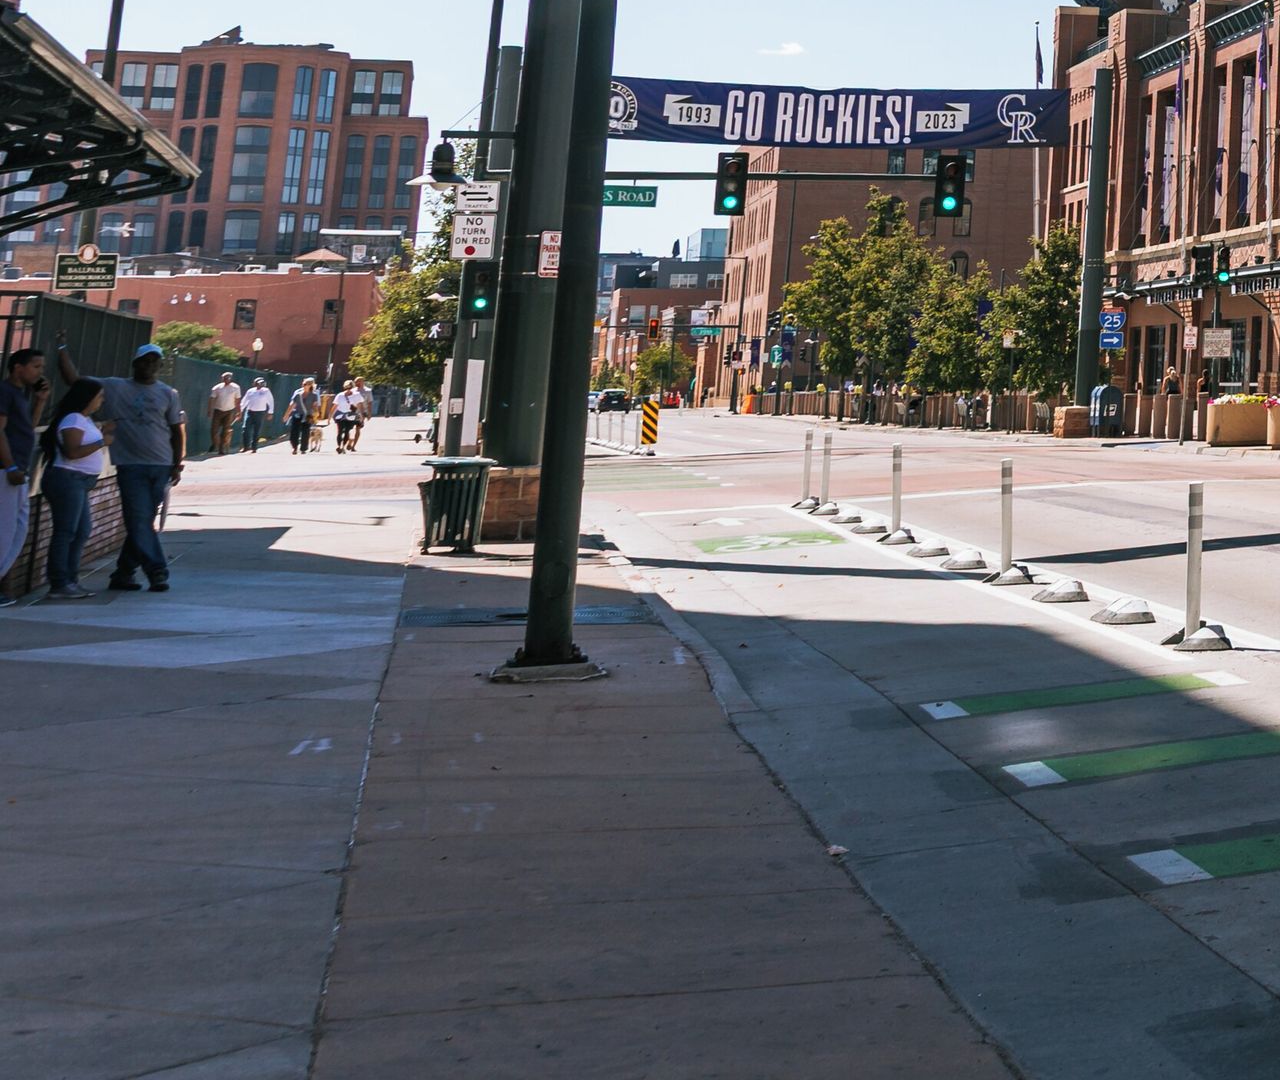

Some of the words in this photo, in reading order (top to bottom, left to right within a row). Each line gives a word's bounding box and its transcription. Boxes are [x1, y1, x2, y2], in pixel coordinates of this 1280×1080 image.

[678, 105, 713, 124] 1993
[724, 90, 766, 142] GO
[774, 91, 914, 145] ROCKIES!
[925, 113, 956, 129] 2023
[466, 217, 483, 226] NO
[462, 227, 486, 235] TURN
[455, 237, 468, 245] ON
[472, 237, 490, 245] RED
[550, 234, 559, 244] NO
[543, 245, 560, 253] PARKIN
[1104, 315, 1121, 328] 25
